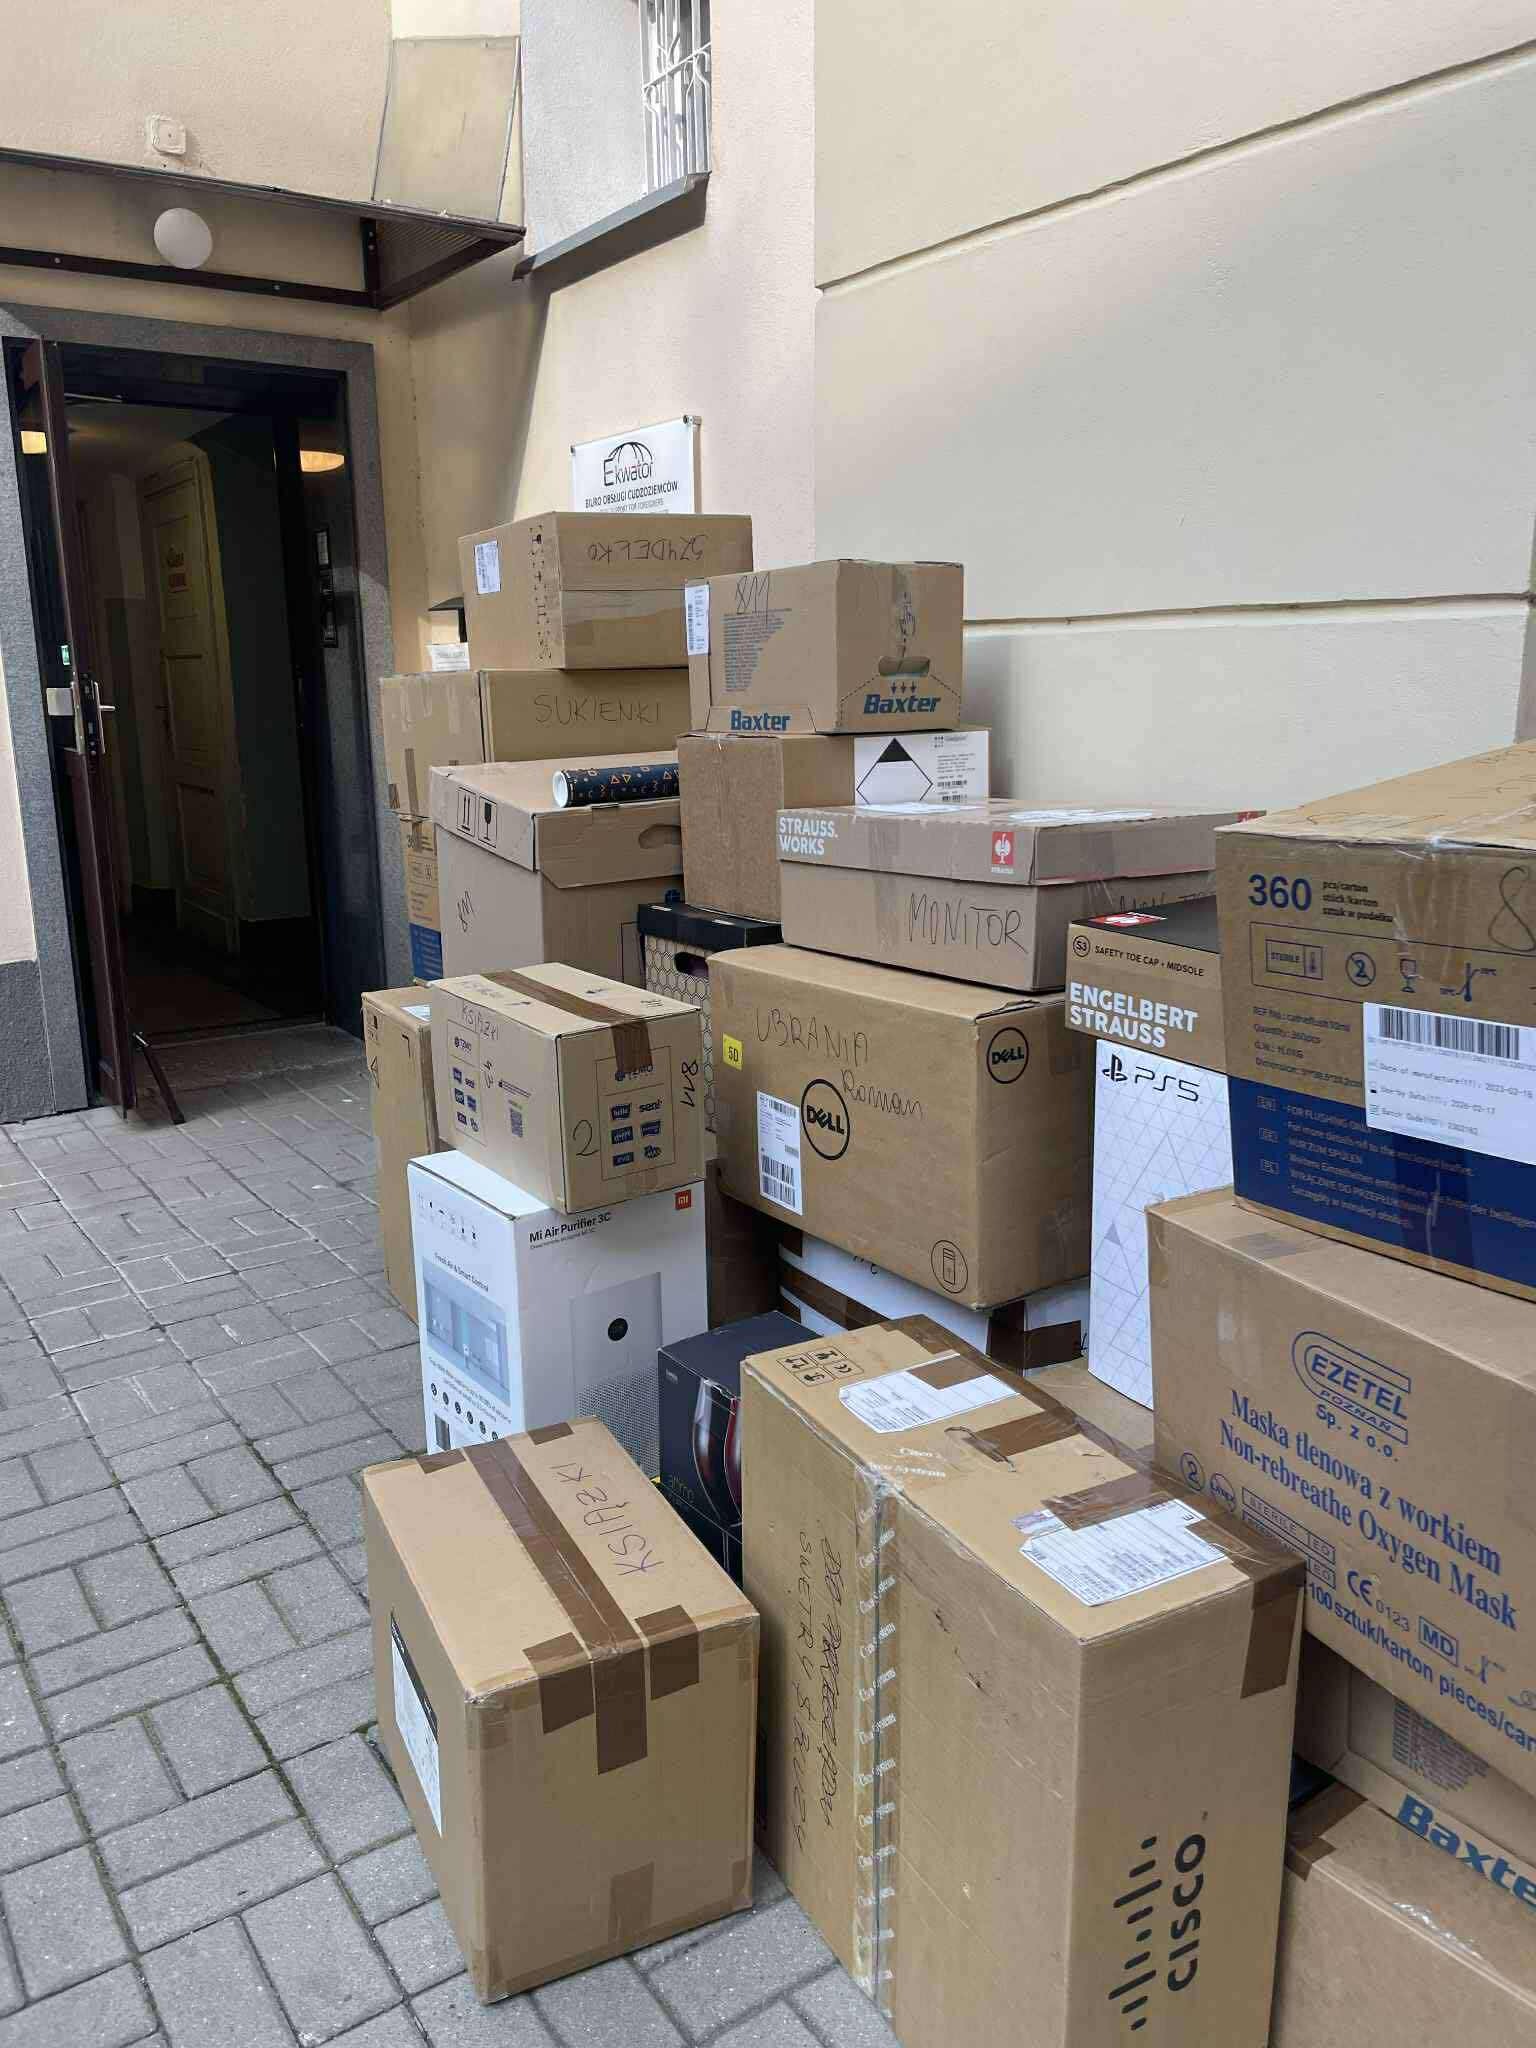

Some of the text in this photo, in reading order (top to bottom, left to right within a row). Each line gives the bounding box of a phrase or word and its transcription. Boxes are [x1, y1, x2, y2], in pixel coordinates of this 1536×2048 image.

[603, 457, 654, 486] Ekwator
[585, 496, 601, 508] BIURO
[627, 480, 678, 500] CUDZOZIEMCÓW
[533, 694, 661, 726] SUKIENKI
[863, 693, 942, 714] Baxter
[730, 709, 791, 731] Baxter
[780, 835, 825, 856] WORKS
[1248, 874, 1312, 911] 360
[908, 891, 1029, 954] MONITOR
[1076, 940, 1088, 951] S3
[1095, 945, 1123, 960] SAFETY
[1126, 951, 1142, 964] TOE
[1143, 955, 1159, 968] CAP
[1167, 961, 1204, 977] MIDSOLE
[1070, 982, 1198, 1032] ENGELBERT
[756, 1007, 868, 1068] UBRANIA
[1070, 1005, 1167, 1048] STRAUSS
[992, 1046, 1025, 1064] DELL
[1134, 1066, 1201, 1102] PS5
[806, 1105, 845, 1135] DELL
[572, 1119, 600, 1156] 2
[529, 1229, 543, 1243] Mi
[545, 1226, 559, 1240] Air
[560, 1215, 597, 1233] Purifier
[597, 1212, 613, 1223] 3C
[1311, 1353, 1407, 1420] EZETEL
[1316, 1403, 1342, 1430] Sp.
[1350, 1424, 1360, 1440] z
[1232, 1389, 1502, 1577] Maska tlenowa z workiem
[1219, 1418, 1352, 1527] Non-rebreathe
[1359, 1508, 1441, 1585] Oxygen
[1449, 1560, 1517, 1632] Mask
[1312, 1538, 1330, 1556] EO
[1312, 1561, 1330, 1581] EO
[1308, 1581, 1333, 1610] 100
[1334, 1601, 1434, 1683] sztuk/karton
[1375, 1600, 1410, 1632] 0123
[1422, 1624, 1455, 1657] MD
